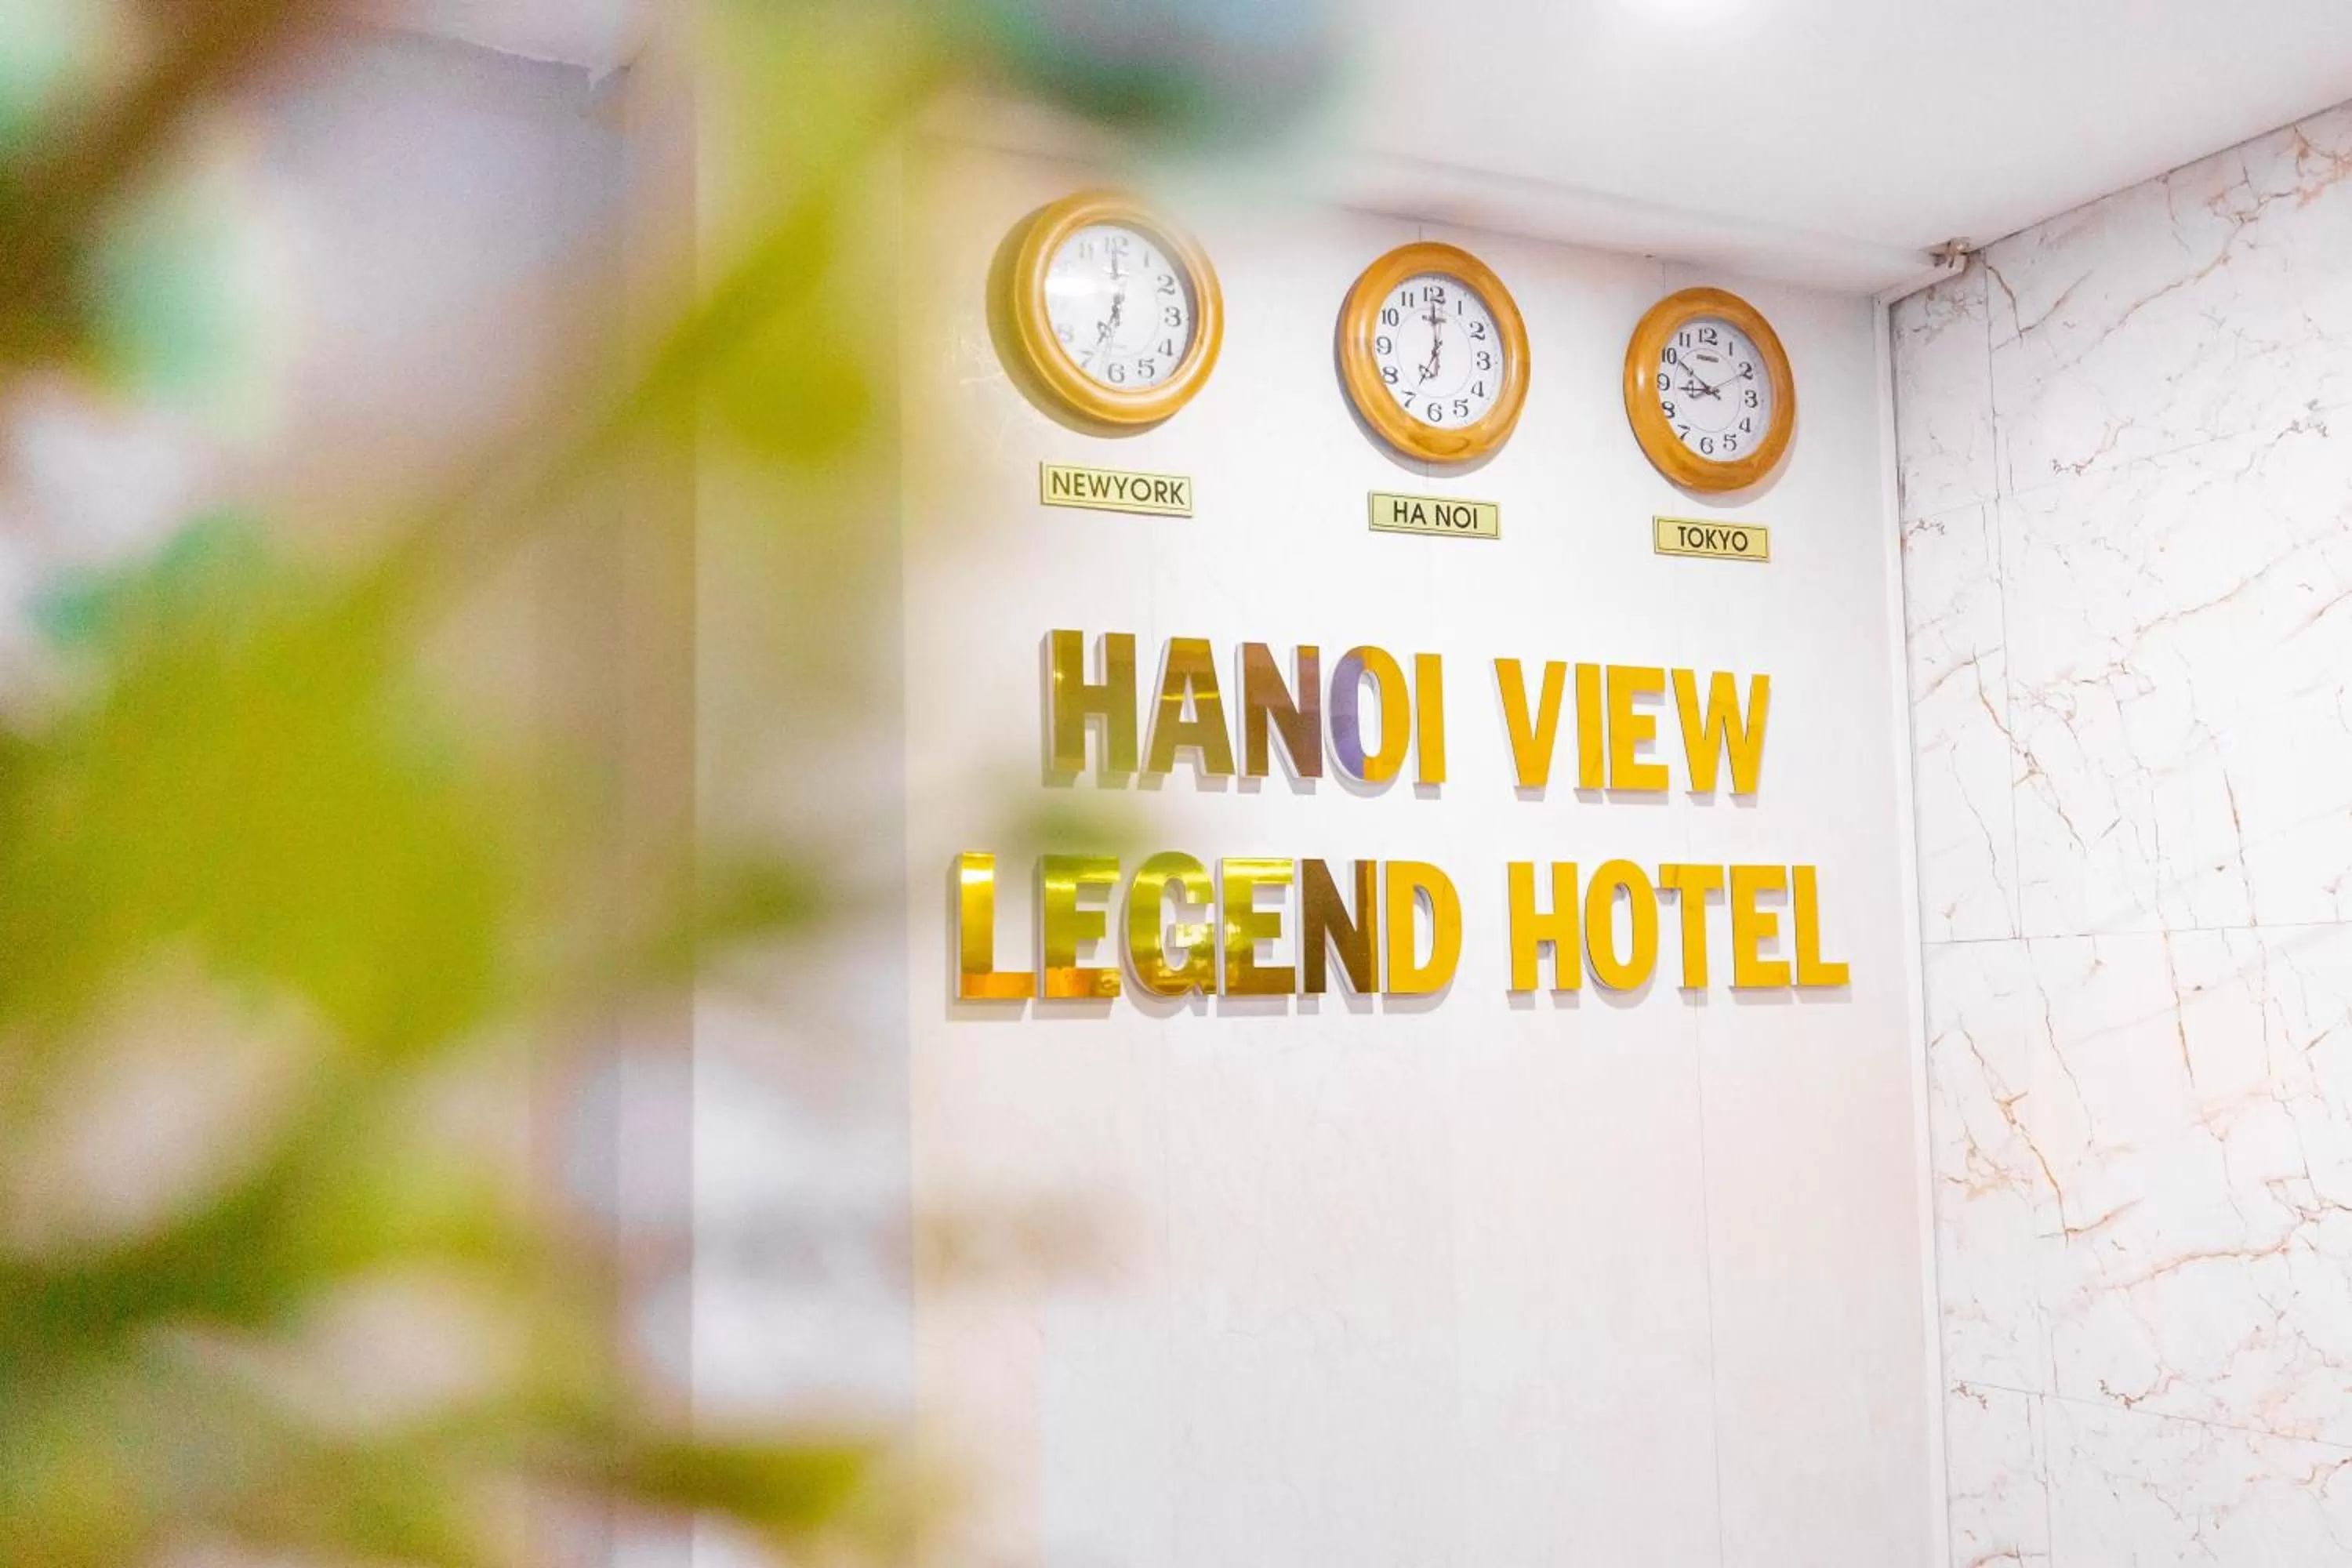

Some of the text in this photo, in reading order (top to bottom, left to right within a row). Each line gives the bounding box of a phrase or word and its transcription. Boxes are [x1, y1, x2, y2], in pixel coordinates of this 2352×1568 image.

[1143, 250, 1150, 268] 1
[1157, 274, 1175, 295] 2
[1402, 291, 1414, 308] 11
[1423, 286, 1446, 304] 12
[1164, 306, 1181, 327] 3
[1381, 308, 1399, 327] 10
[1457, 300, 1463, 316] 1
[1469, 321, 1486, 340] 2
[1679, 332, 1691, 348] 11
[1698, 327, 1718, 346] 12
[1157, 338, 1174, 357] 4
[1376, 336, 1392, 355] 9
[1728, 341, 1733, 356] 1
[1080, 350, 1094, 368] 7
[1476, 351, 1491, 371] 3
[1661, 347, 1677, 365] 10
[1108, 363, 1125, 383] 6
[1138, 358, 1155, 379] 5
[1382, 365, 1399, 385] 8
[1738, 361, 1754, 380] 2
[1471, 381, 1484, 397] 4
[1657, 372, 1671, 391] 9
[1402, 390, 1417, 408] 7
[1453, 398, 1469, 418] 5
[1744, 389, 1759, 408] 3
[1427, 402, 1443, 422] 6
[1661, 401, 1675, 419] 8
[1677, 424, 1691, 441] 7
[1738, 417, 1751, 433] 4
[1700, 437, 1714, 455] 6
[1722, 434, 1737, 452] 5
[1051, 470, 1185, 506] NEWYORK
[1393, 499, 1478, 529] HA NOI
[1677, 526, 1748, 552] TOKYO
[1049, 629, 1771, 794] HANOI VIEW
[957, 850, 1850, 998] LEGEND HOTEL
